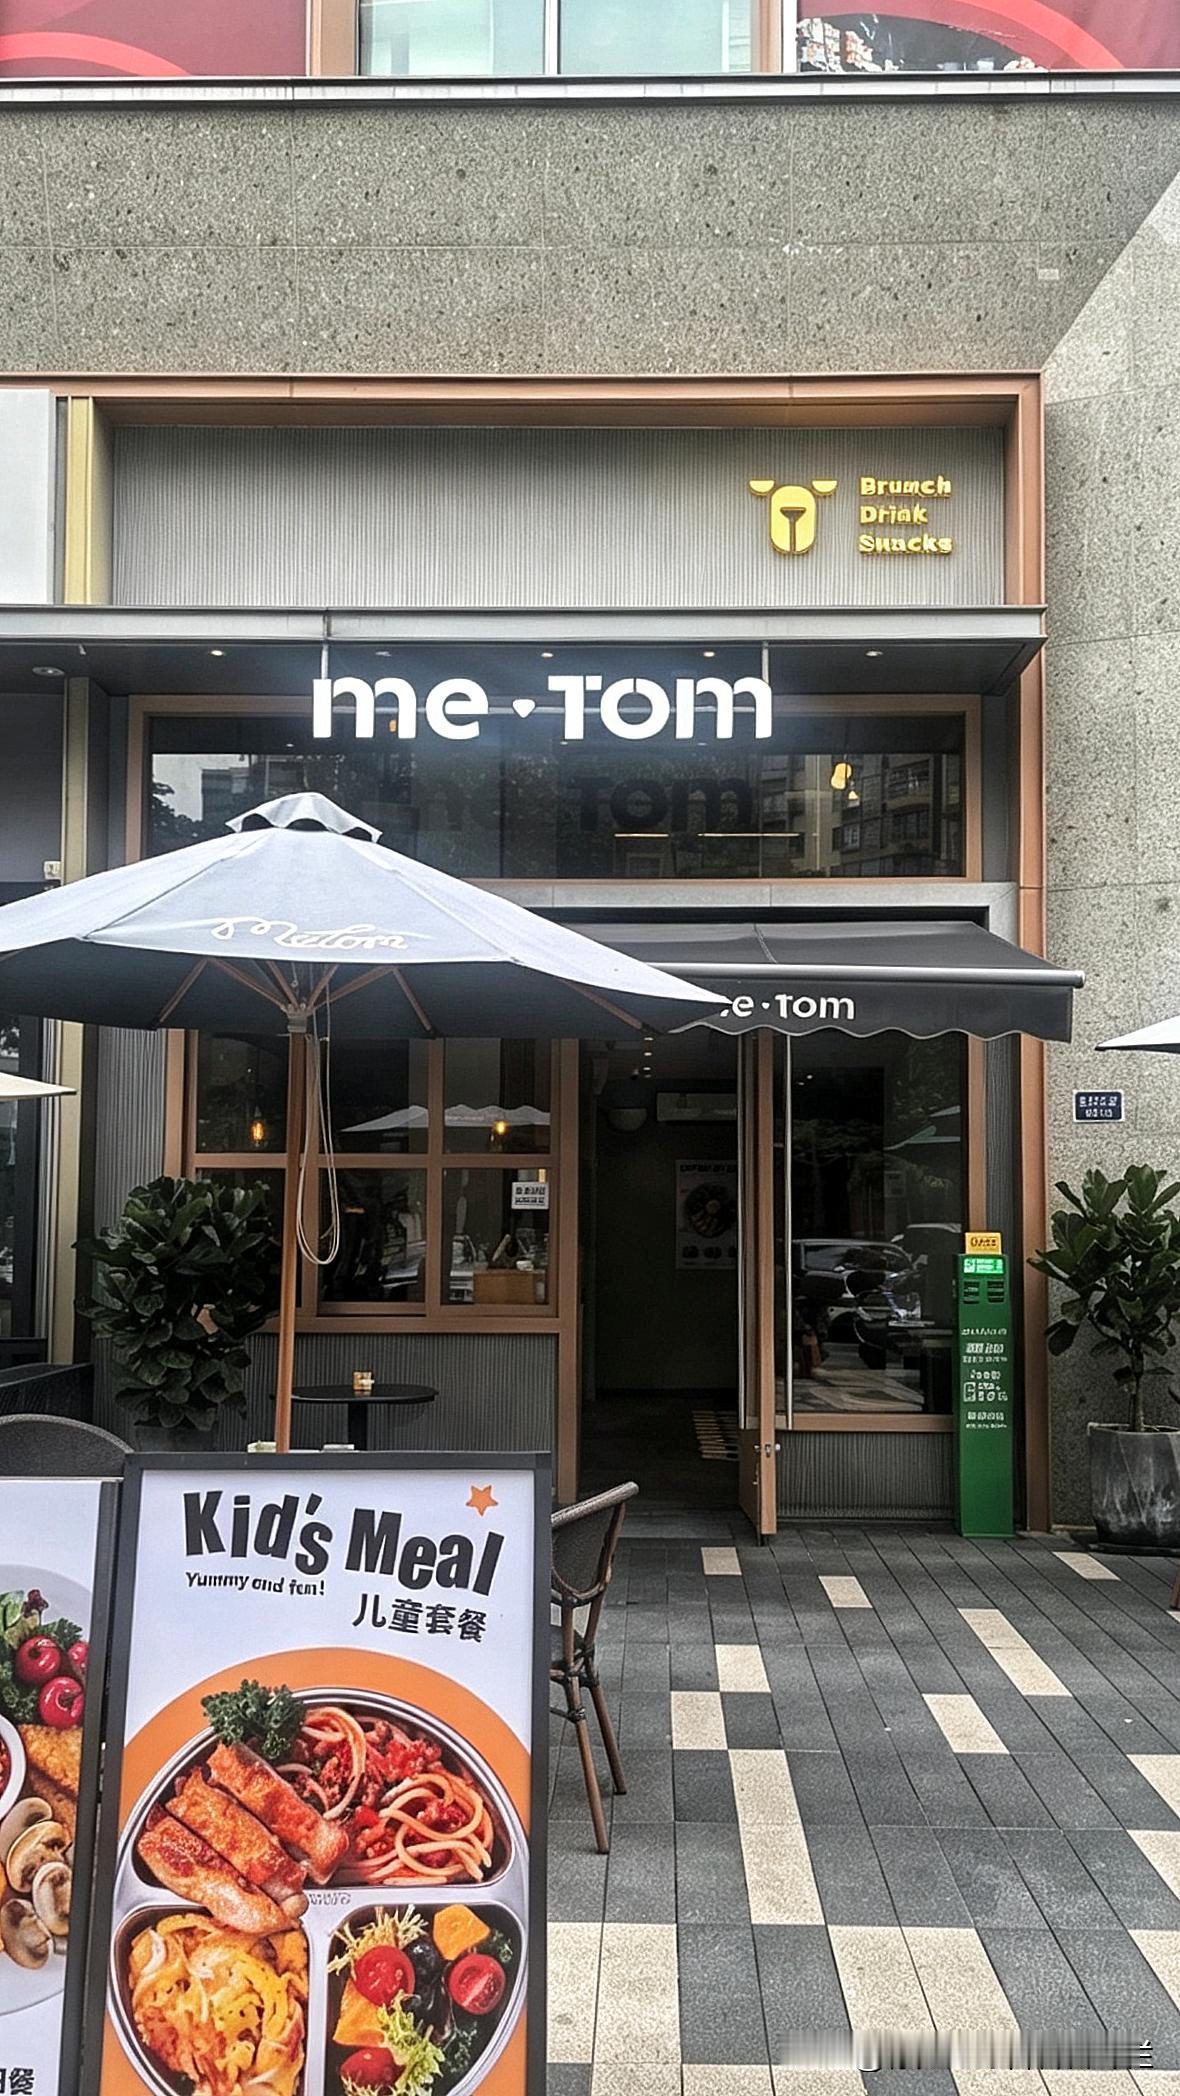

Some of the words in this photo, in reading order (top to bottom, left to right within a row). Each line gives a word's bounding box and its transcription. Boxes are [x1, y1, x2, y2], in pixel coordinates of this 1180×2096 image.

[860, 475, 952, 498] Brunch
[183, 1490, 333, 1576] Kid's
[345, 1508, 505, 1597] Meal
[185, 1572, 250, 1591] Yummy
[352, 1593, 487, 1643] 儿童套餐
